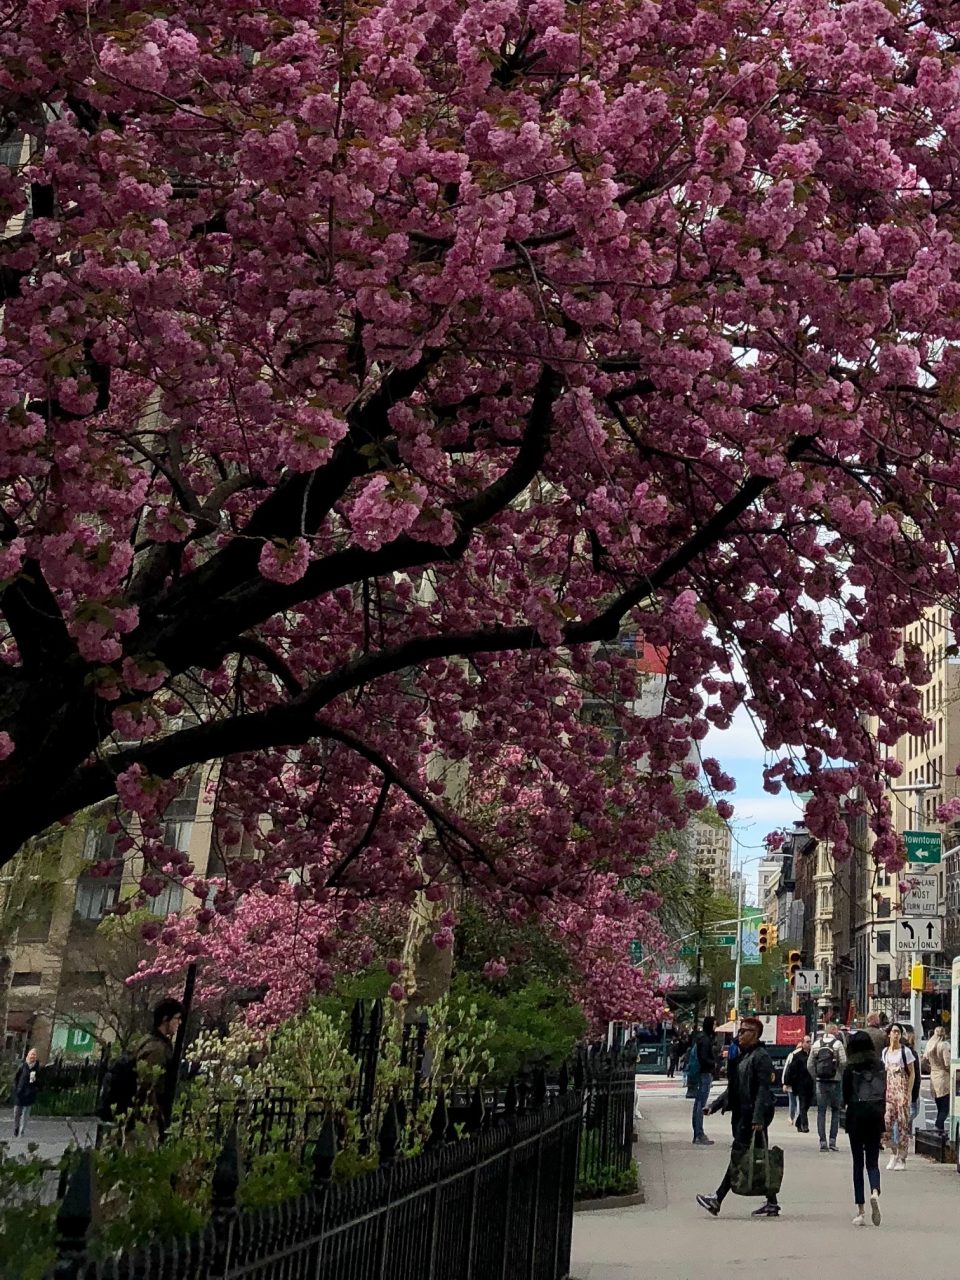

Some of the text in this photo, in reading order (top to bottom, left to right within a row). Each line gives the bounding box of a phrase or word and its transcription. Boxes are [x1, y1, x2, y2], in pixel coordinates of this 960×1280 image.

[921, 879, 935, 887] LANE
[911, 890, 930, 900] MUST
[906, 902, 936, 912] TURN LEFT
[898, 941, 939, 949] ONLY ONLY
